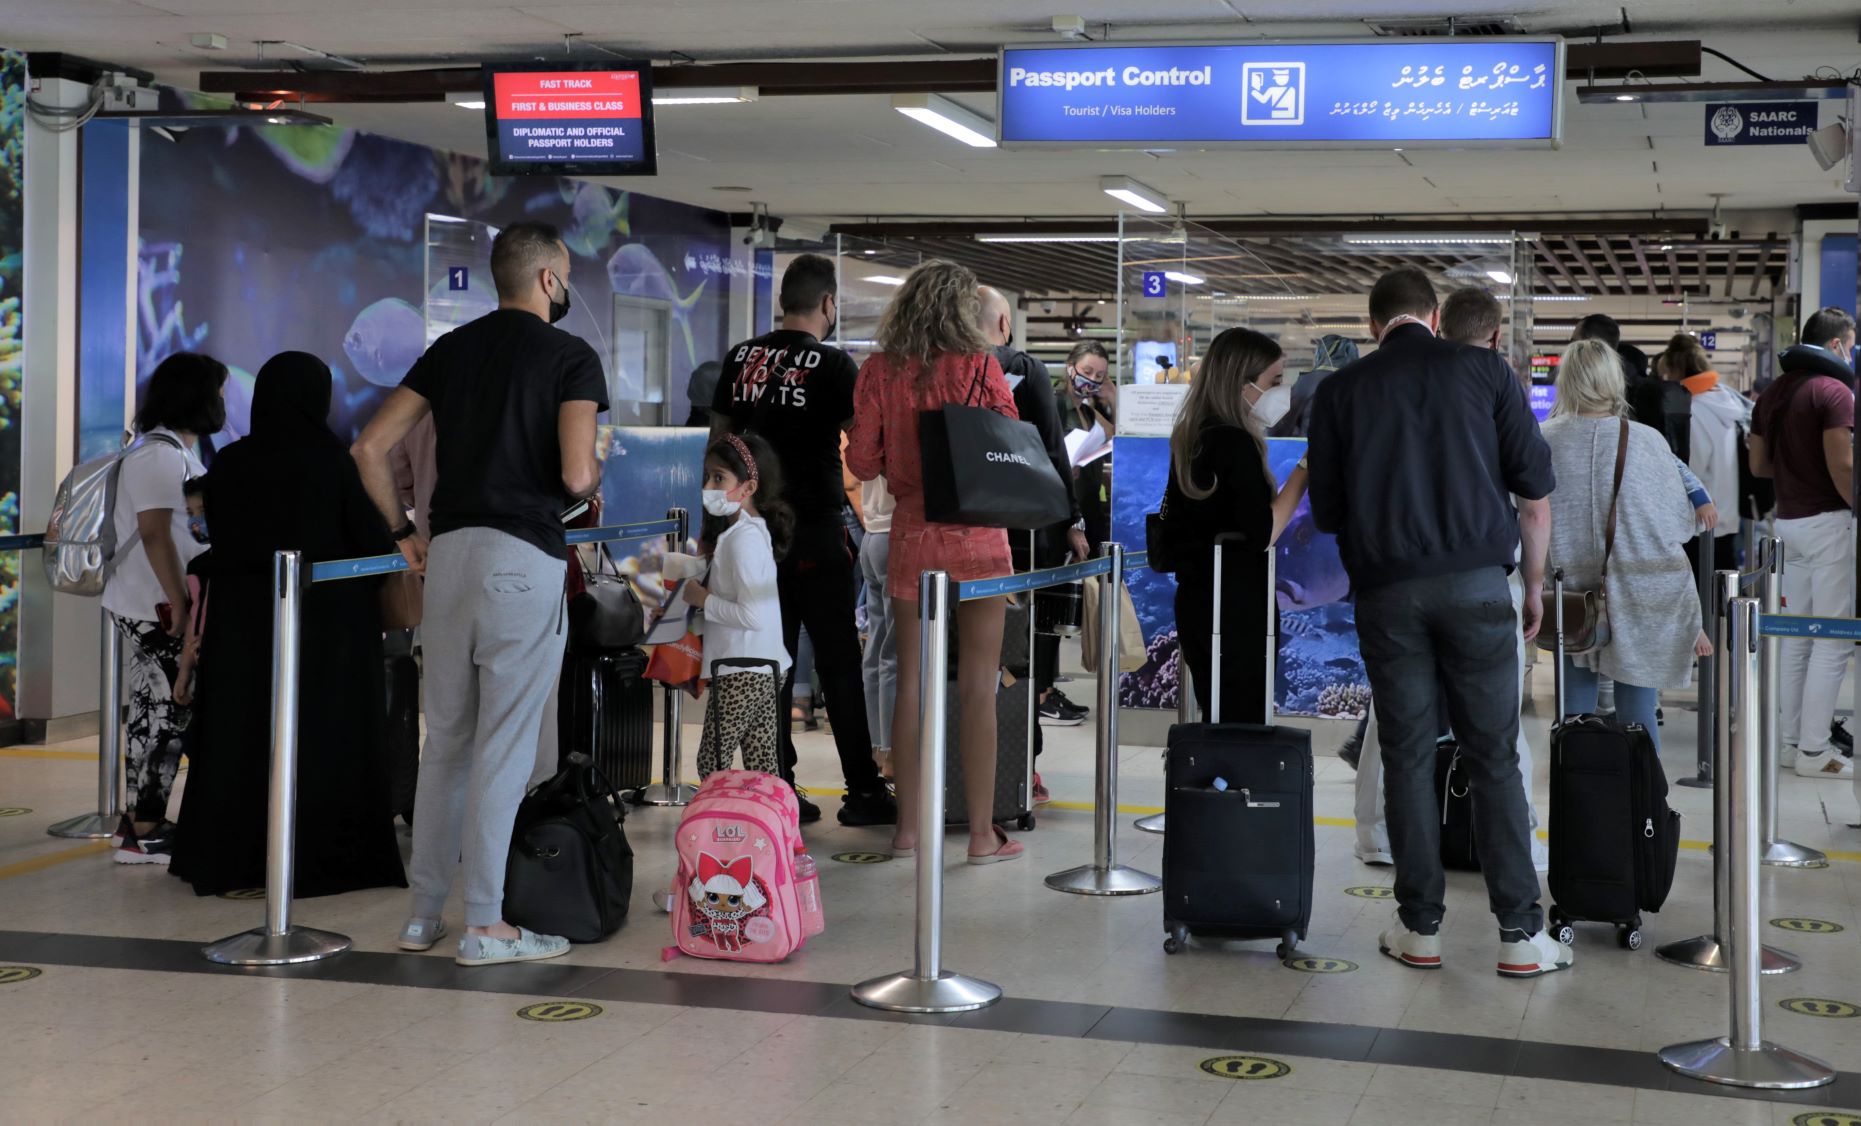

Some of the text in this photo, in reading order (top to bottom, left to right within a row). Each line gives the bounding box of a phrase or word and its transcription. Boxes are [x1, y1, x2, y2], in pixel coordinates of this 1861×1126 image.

[540, 79, 592, 88] FAST TRACK
[1010, 66, 1212, 91] Passport Control
[511, 101, 623, 111] FIRST & BUSINESS CLASS
[1063, 104, 1176, 117] Tourist / Visa Holders
[1749, 111, 1797, 122] SAARC
[513, 127, 625, 137] DIPLOMATIC AND OFFICIAL
[1749, 125, 1814, 137] Nationals
[528, 138, 614, 148] PASSPORT HOLDERS
[454, 269, 463, 288] 1
[1148, 275, 1161, 294] 3
[1701, 335, 1715, 346] 12
[732, 382, 806, 407] LIMTS
[985, 451, 1031, 466] CHANEL
